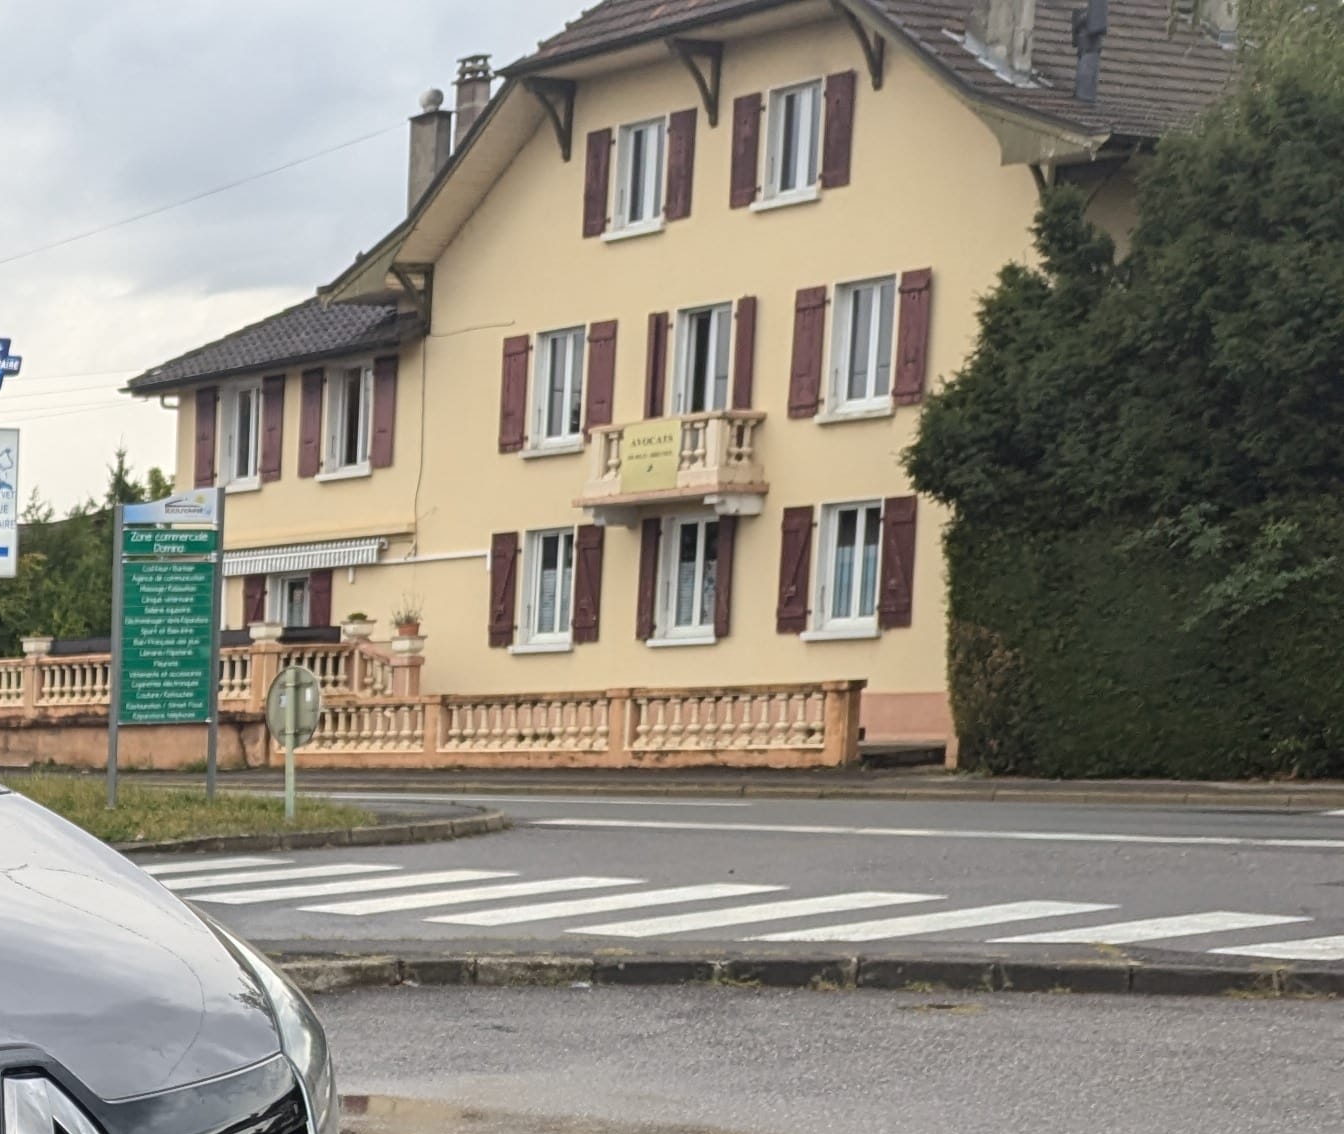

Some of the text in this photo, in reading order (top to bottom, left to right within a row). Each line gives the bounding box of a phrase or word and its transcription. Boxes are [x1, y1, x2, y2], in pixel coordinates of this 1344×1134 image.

[130, 531, 208, 542] Zone commerciale
[153, 543, 185, 553] Domino
